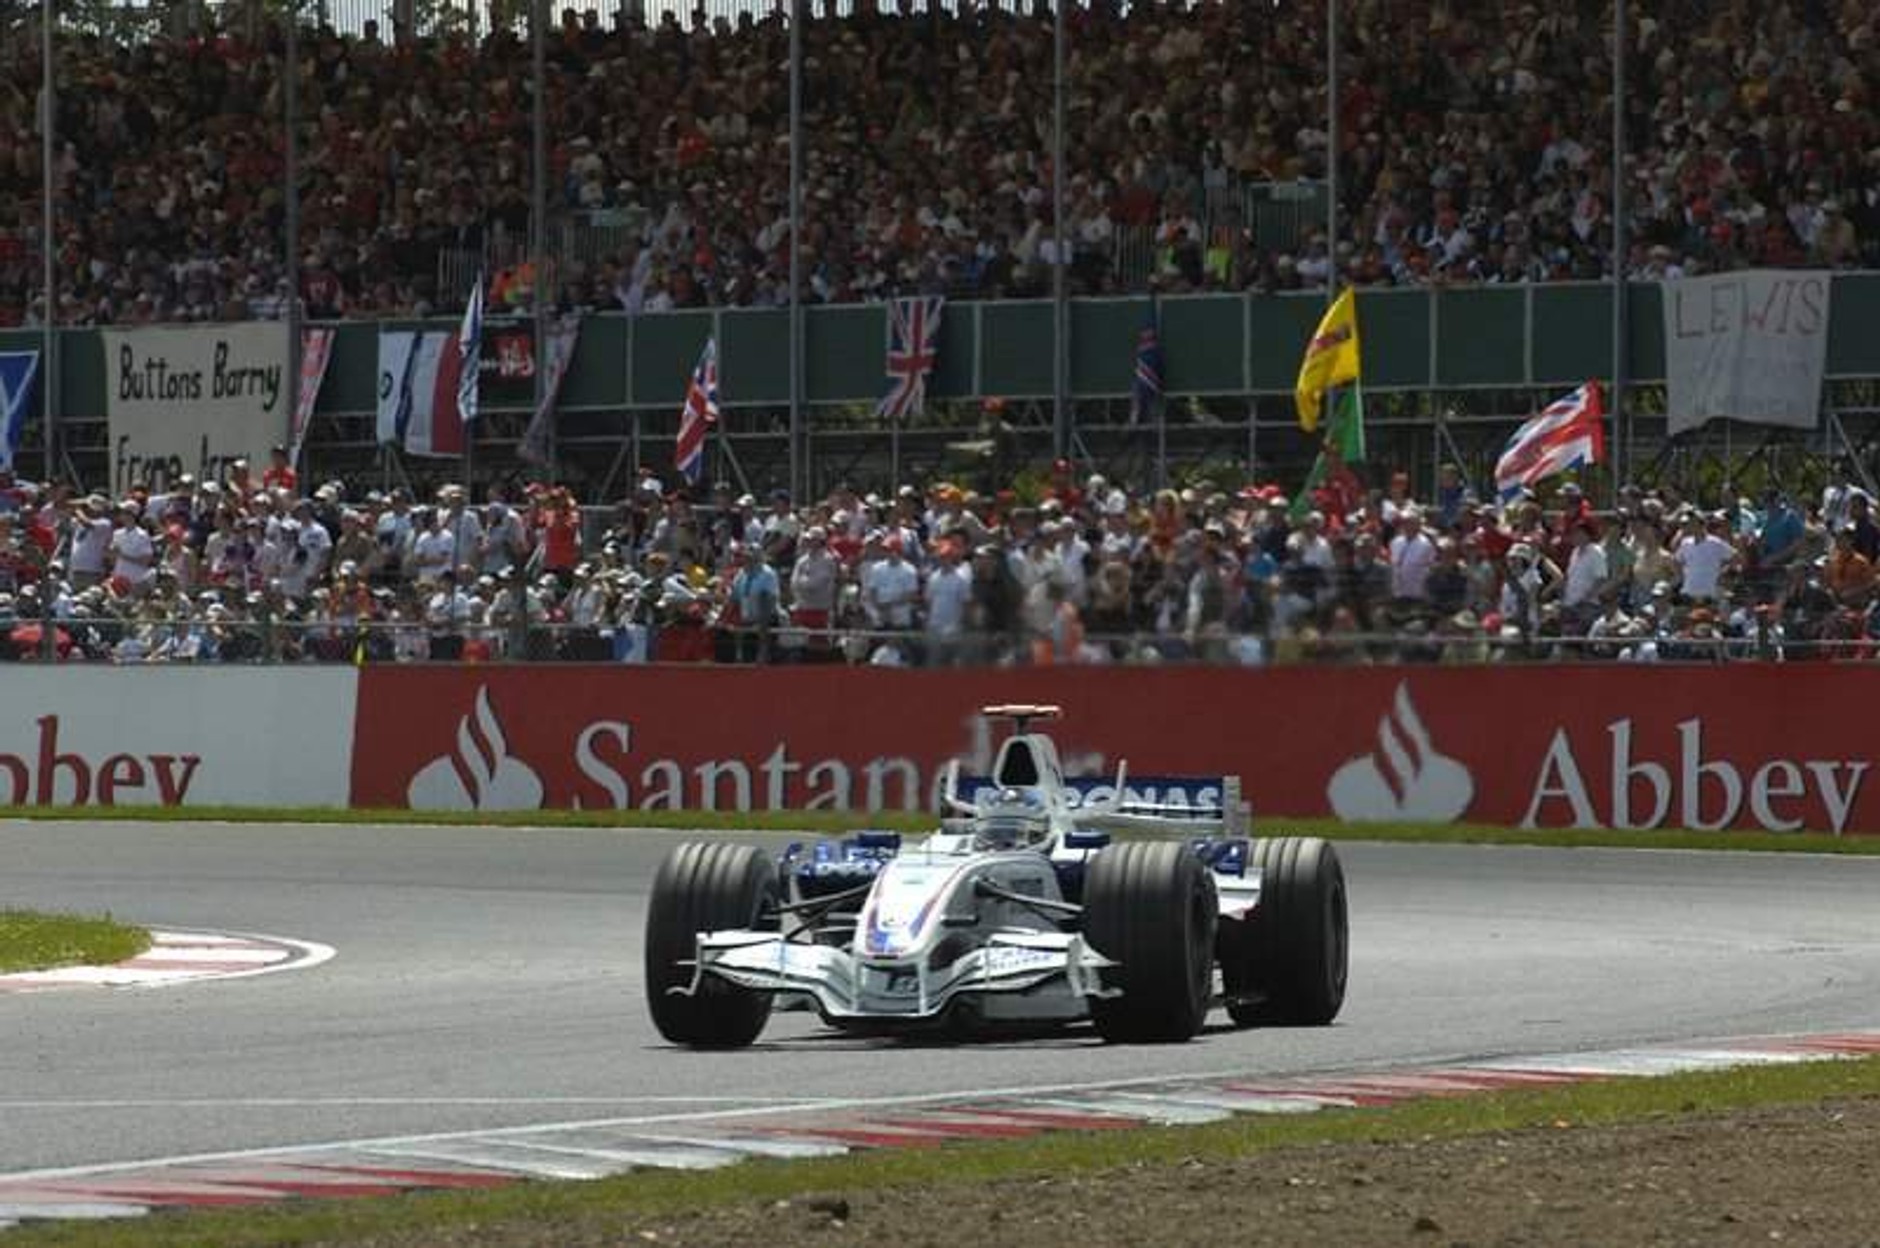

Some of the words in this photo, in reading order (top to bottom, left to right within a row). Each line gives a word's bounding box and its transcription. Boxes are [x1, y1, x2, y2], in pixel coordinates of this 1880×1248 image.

[1675, 278, 1824, 339] LEWIS
[118, 343, 203, 401] Buttons
[1519, 717, 1870, 837] Abbey
